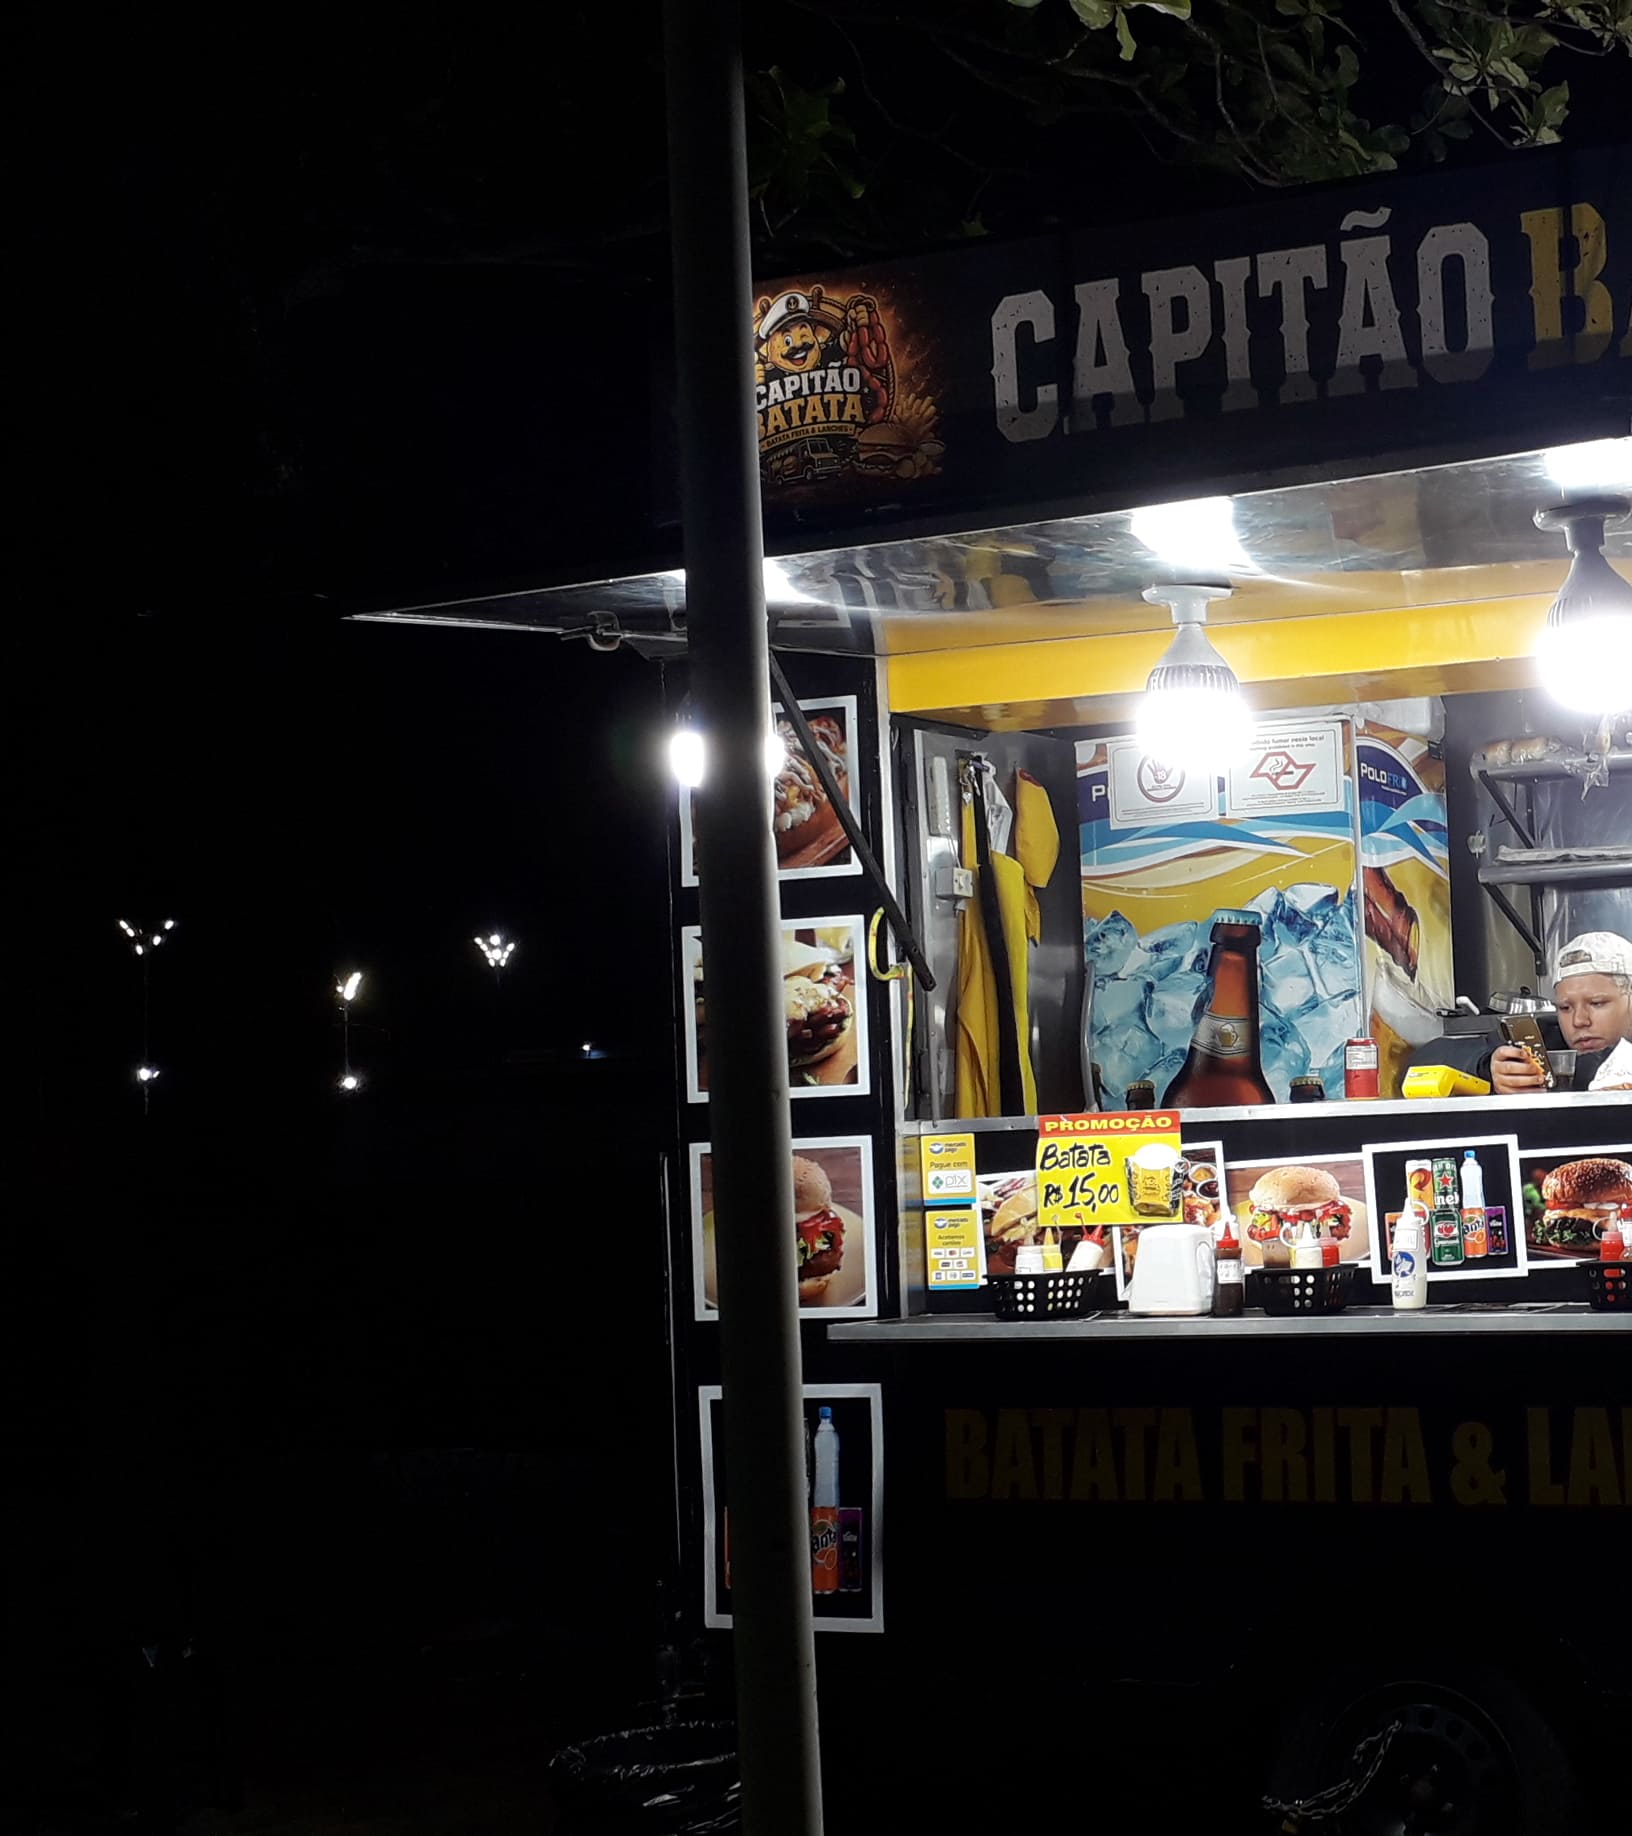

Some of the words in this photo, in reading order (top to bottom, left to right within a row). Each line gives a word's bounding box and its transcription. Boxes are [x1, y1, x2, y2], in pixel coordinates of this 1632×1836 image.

[989, 205, 1496, 444] CAPITÃO
[755, 361, 861, 410] CAPITÃO
[1044, 1115, 1172, 1132] PROMOÇÃO
[1040, 1142, 1111, 1171] Batata
[1044, 1183, 1063, 1208] R$
[1063, 1172, 1119, 1212] 15,00
[943, 1406, 1208, 1503] BATATA
[1220, 1406, 1434, 1504] FRITA
[1449, 1420, 1508, 1505] &
